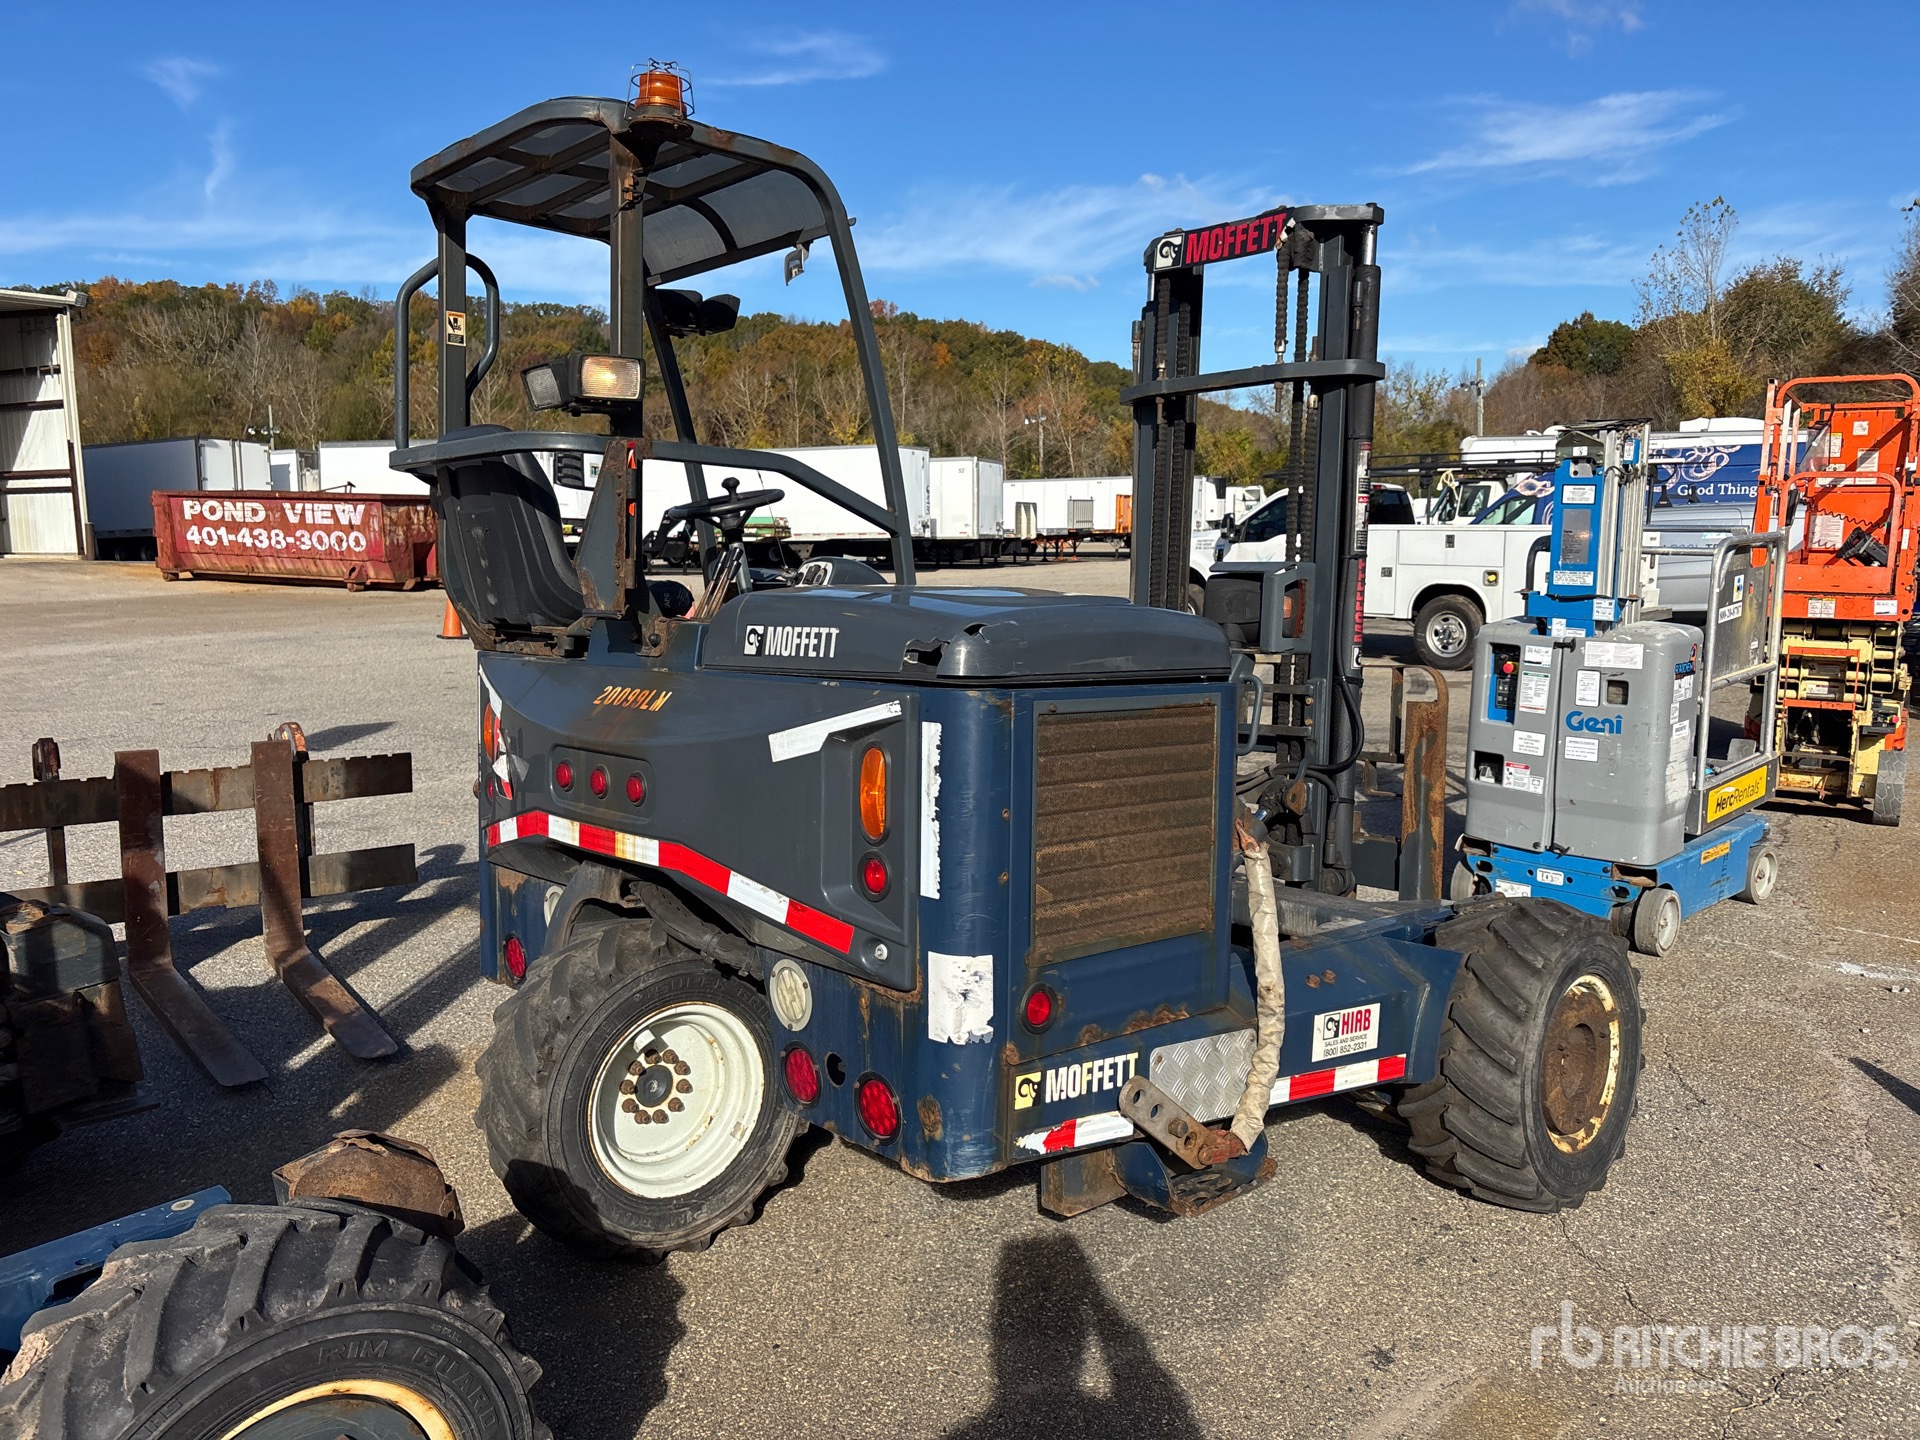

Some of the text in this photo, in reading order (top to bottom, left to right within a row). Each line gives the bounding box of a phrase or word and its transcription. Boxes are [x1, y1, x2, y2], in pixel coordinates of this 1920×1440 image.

[1186, 213, 1287, 264] MOFFETT
[1677, 484, 1714, 496] God
[184, 500, 365, 525] POND VIEW
[186, 525, 367, 552] 401-438-3000
[765, 626, 839, 658] MOFFETT
[1341, 1009, 1371, 1035] HIAB
[1324, 1041, 1367, 1058] (800) 852-2331
[1350, 1034, 1367, 1042] SERVICE
[1045, 1053, 1139, 1104] MOFFETT
